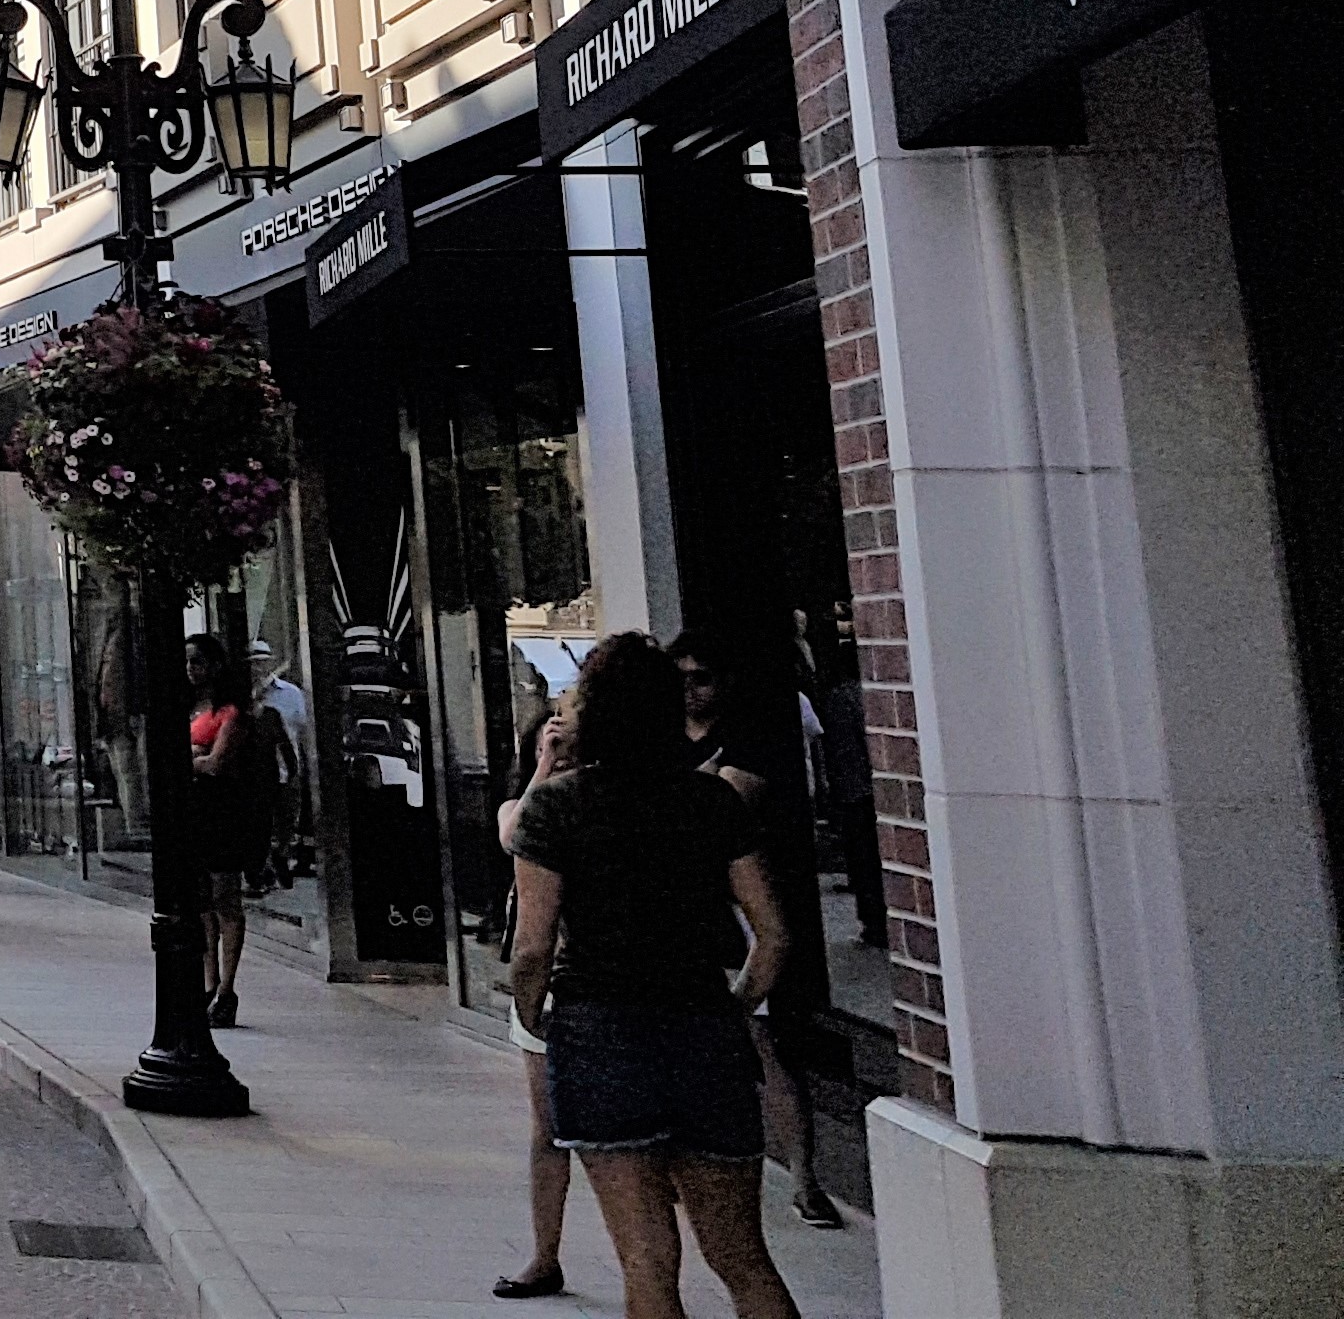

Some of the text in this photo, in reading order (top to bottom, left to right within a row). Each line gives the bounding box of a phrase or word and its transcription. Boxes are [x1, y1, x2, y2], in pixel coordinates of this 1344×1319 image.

[240, 195, 325, 256] PORSCHE
[318, 210, 388, 296] RICHARD MILLE
[9, 309, 53, 345] DESIGN
